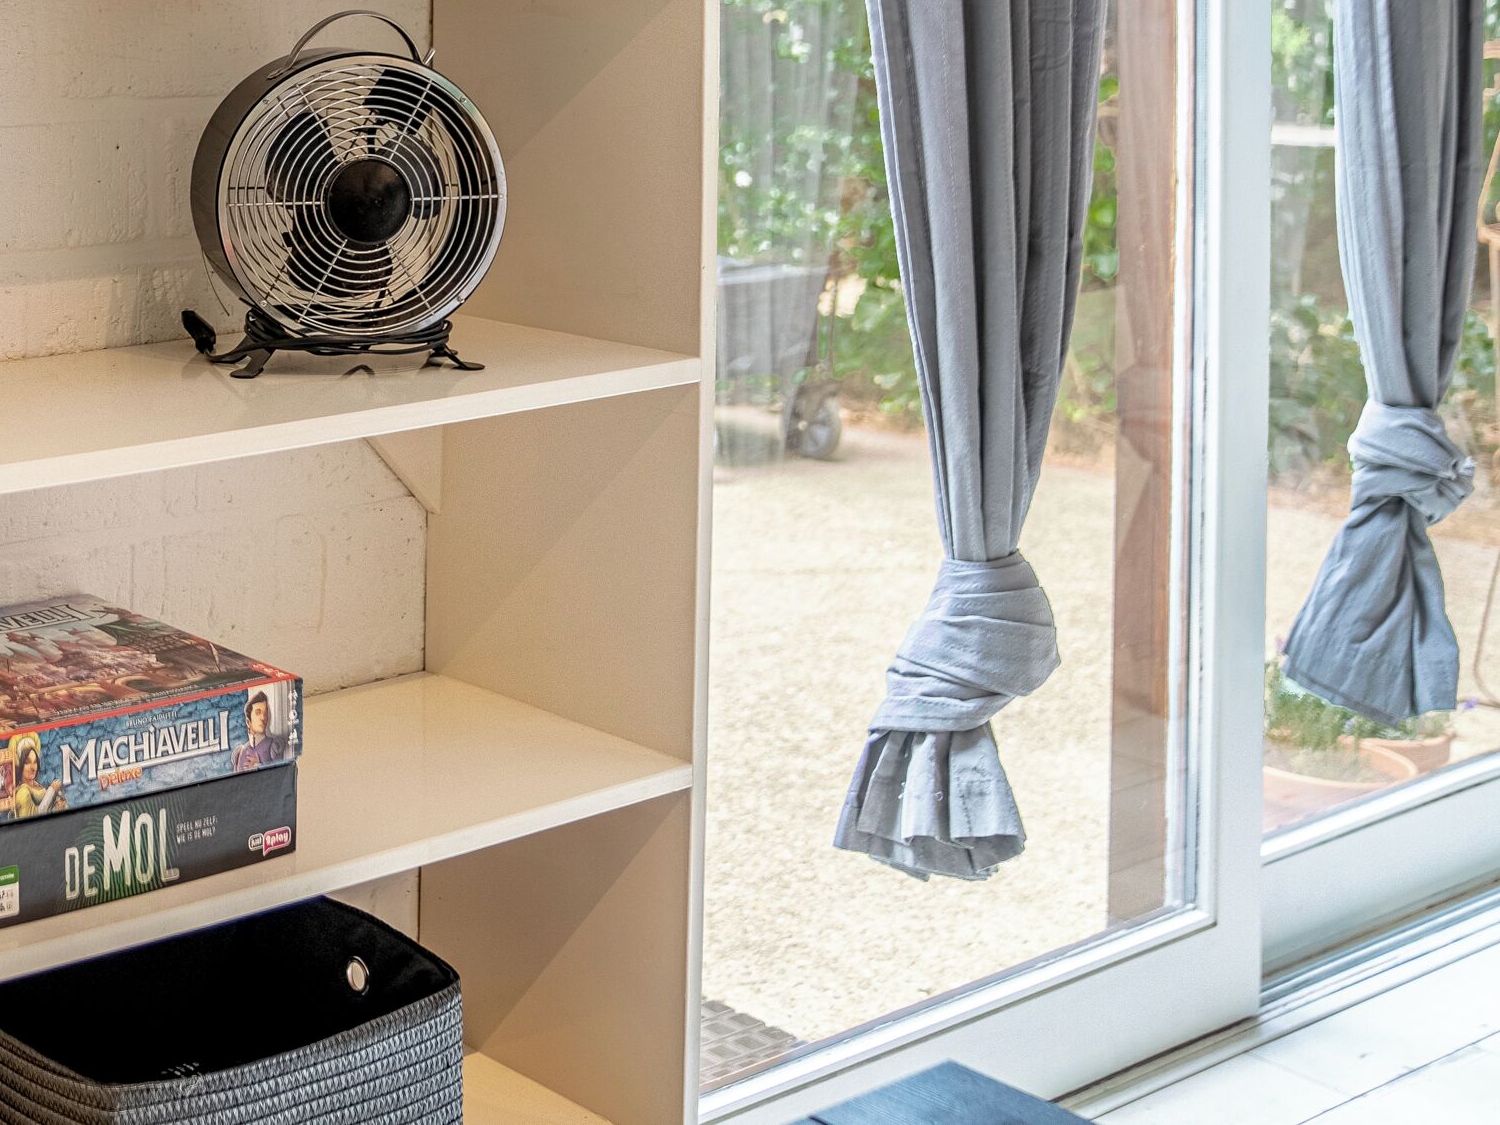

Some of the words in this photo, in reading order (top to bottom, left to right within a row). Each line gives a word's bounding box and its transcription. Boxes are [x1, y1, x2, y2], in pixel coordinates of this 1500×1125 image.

[61, 711, 229, 786] MACHIAVELLI
[100, 766, 143, 791] Deluxe
[64, 844, 98, 900] DE
[103, 808, 180, 892] MOL
